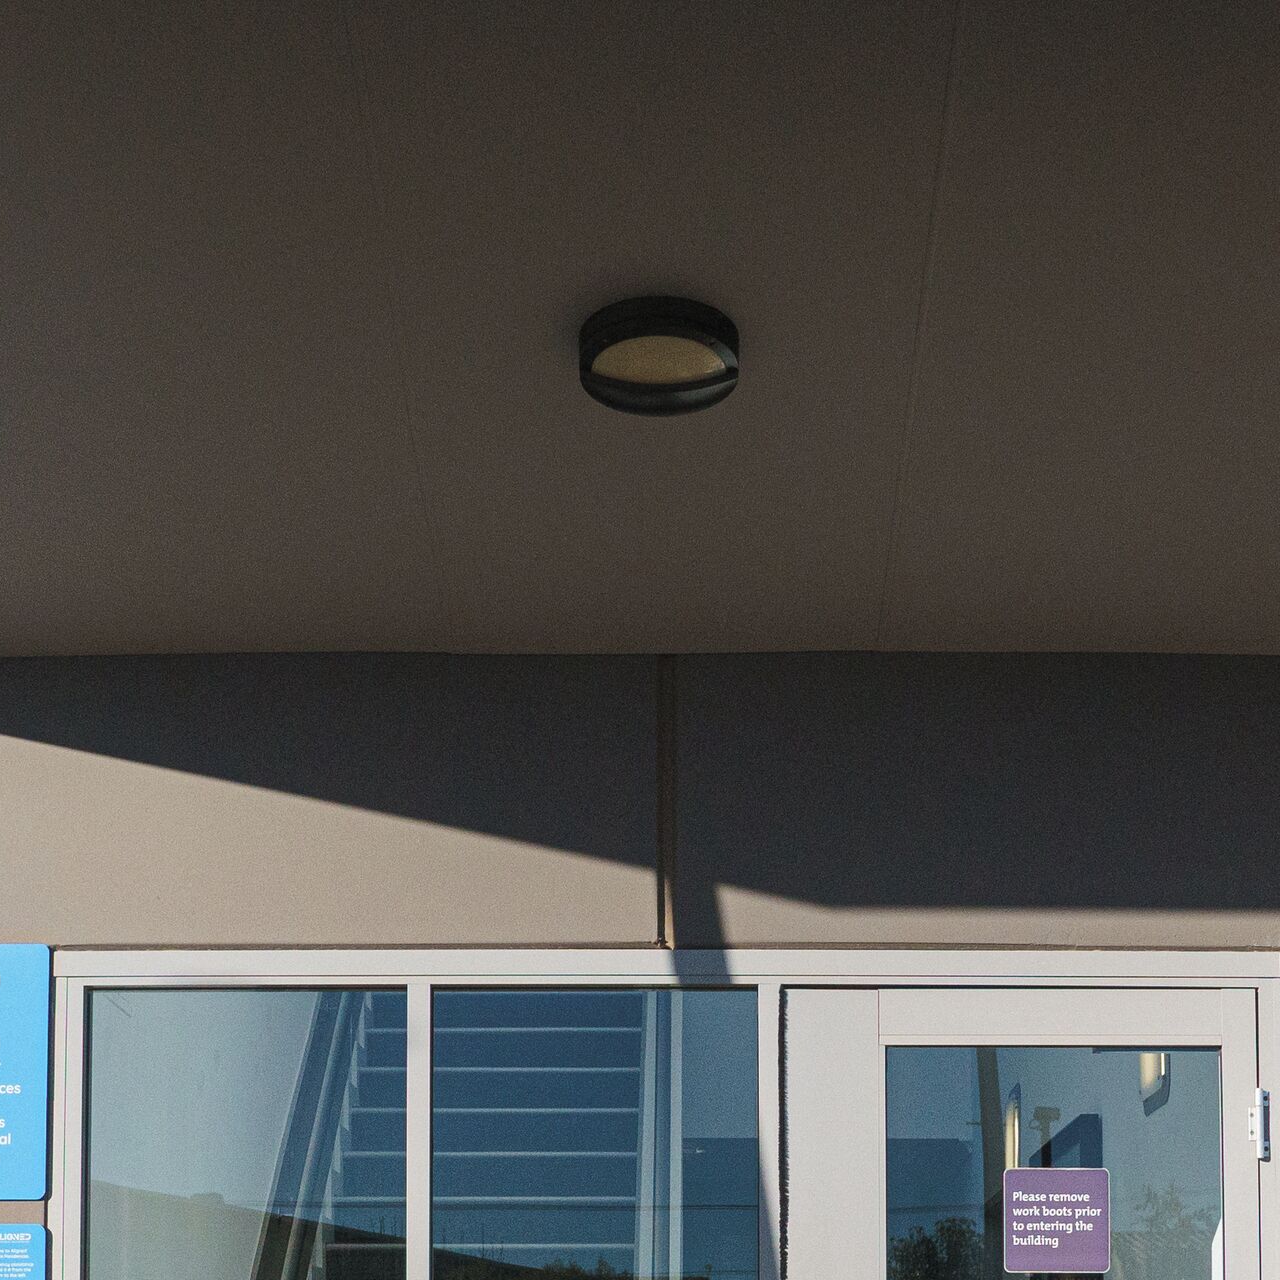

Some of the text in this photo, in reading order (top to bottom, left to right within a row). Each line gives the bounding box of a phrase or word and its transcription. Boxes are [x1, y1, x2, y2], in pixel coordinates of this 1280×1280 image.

[1013, 1191, 1090, 1201] Please remove
[1013, 1206, 1101, 1219] work boots prior
[1013, 1221, 1093, 1233] to entering the
[1013, 1236, 1059, 1248] building
